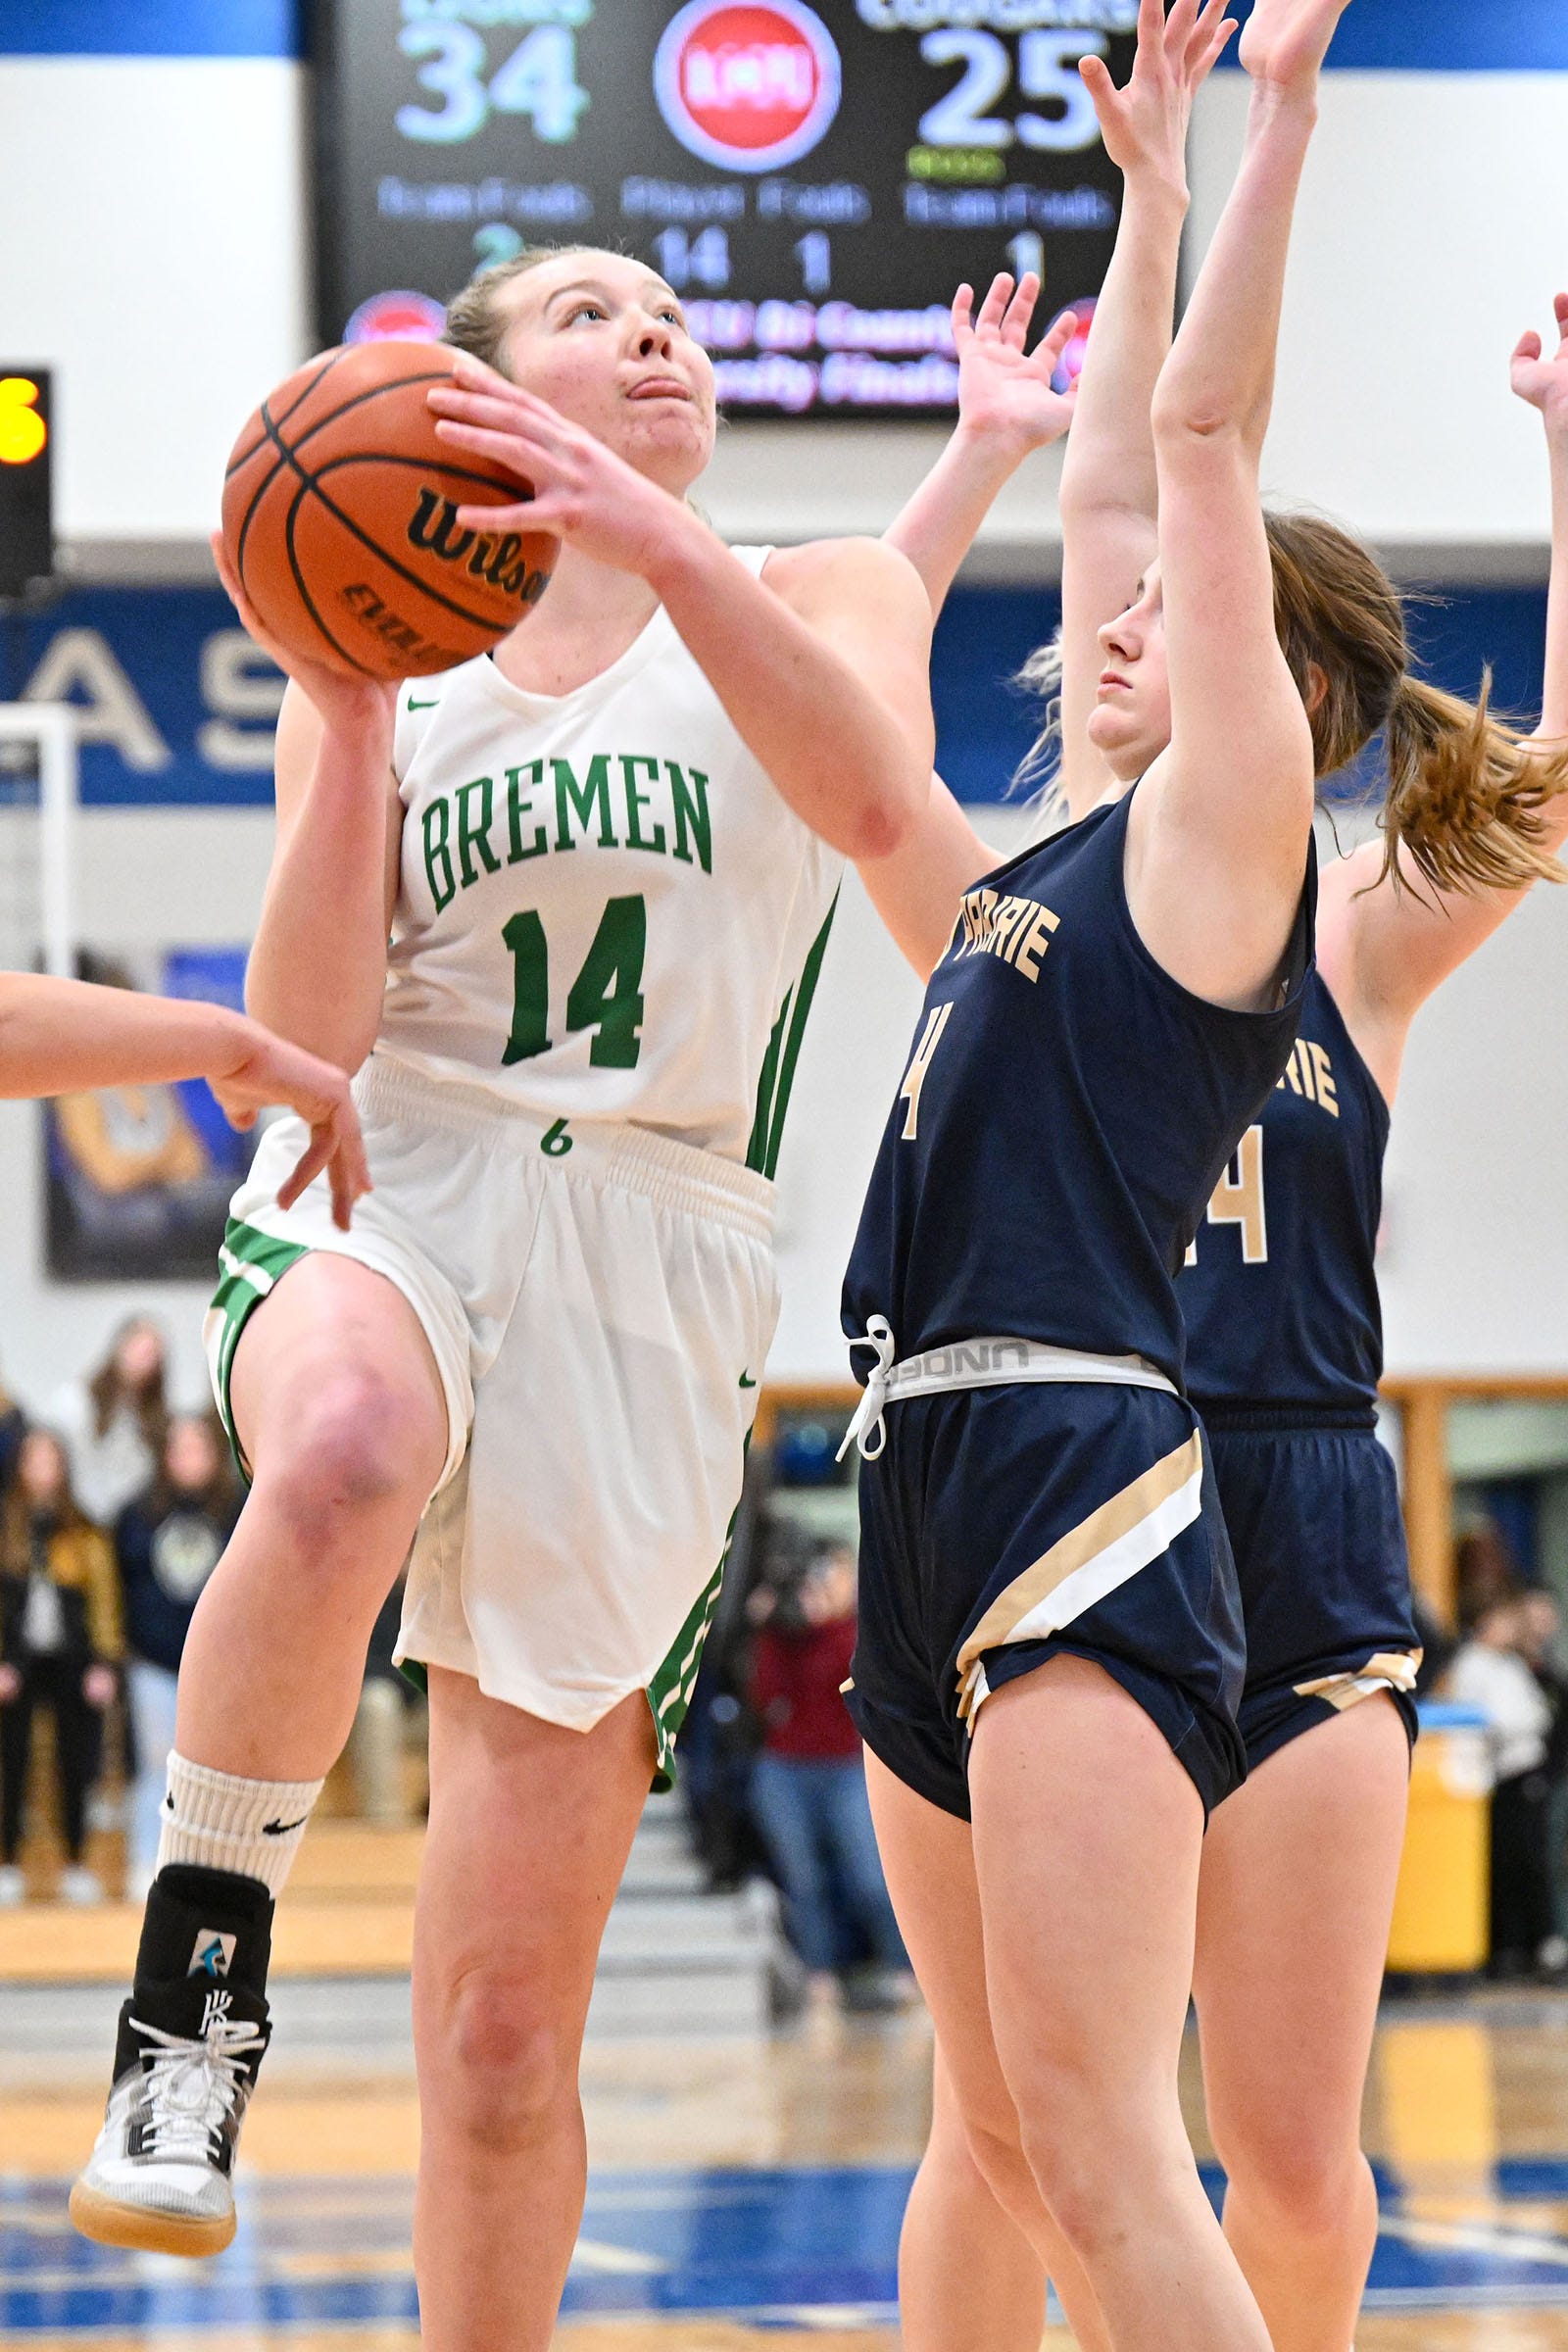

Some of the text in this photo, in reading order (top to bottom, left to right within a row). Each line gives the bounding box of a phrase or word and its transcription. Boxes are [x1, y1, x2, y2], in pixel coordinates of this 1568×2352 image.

[394, 21, 590, 144] 34
[918, 28, 1108, 151] 25
[654, 224, 730, 289] 14
[795, 229, 832, 294] 1
[1006, 230, 1046, 293] 1
[407, 487, 551, 605] Wilso
[421, 754, 713, 915] BREMEN
[501, 894, 647, 1069] 14
[900, 1001, 955, 1140] 4
[540, 1117, 573, 1156] 6
[889, 1340, 1030, 1384] UNDE
